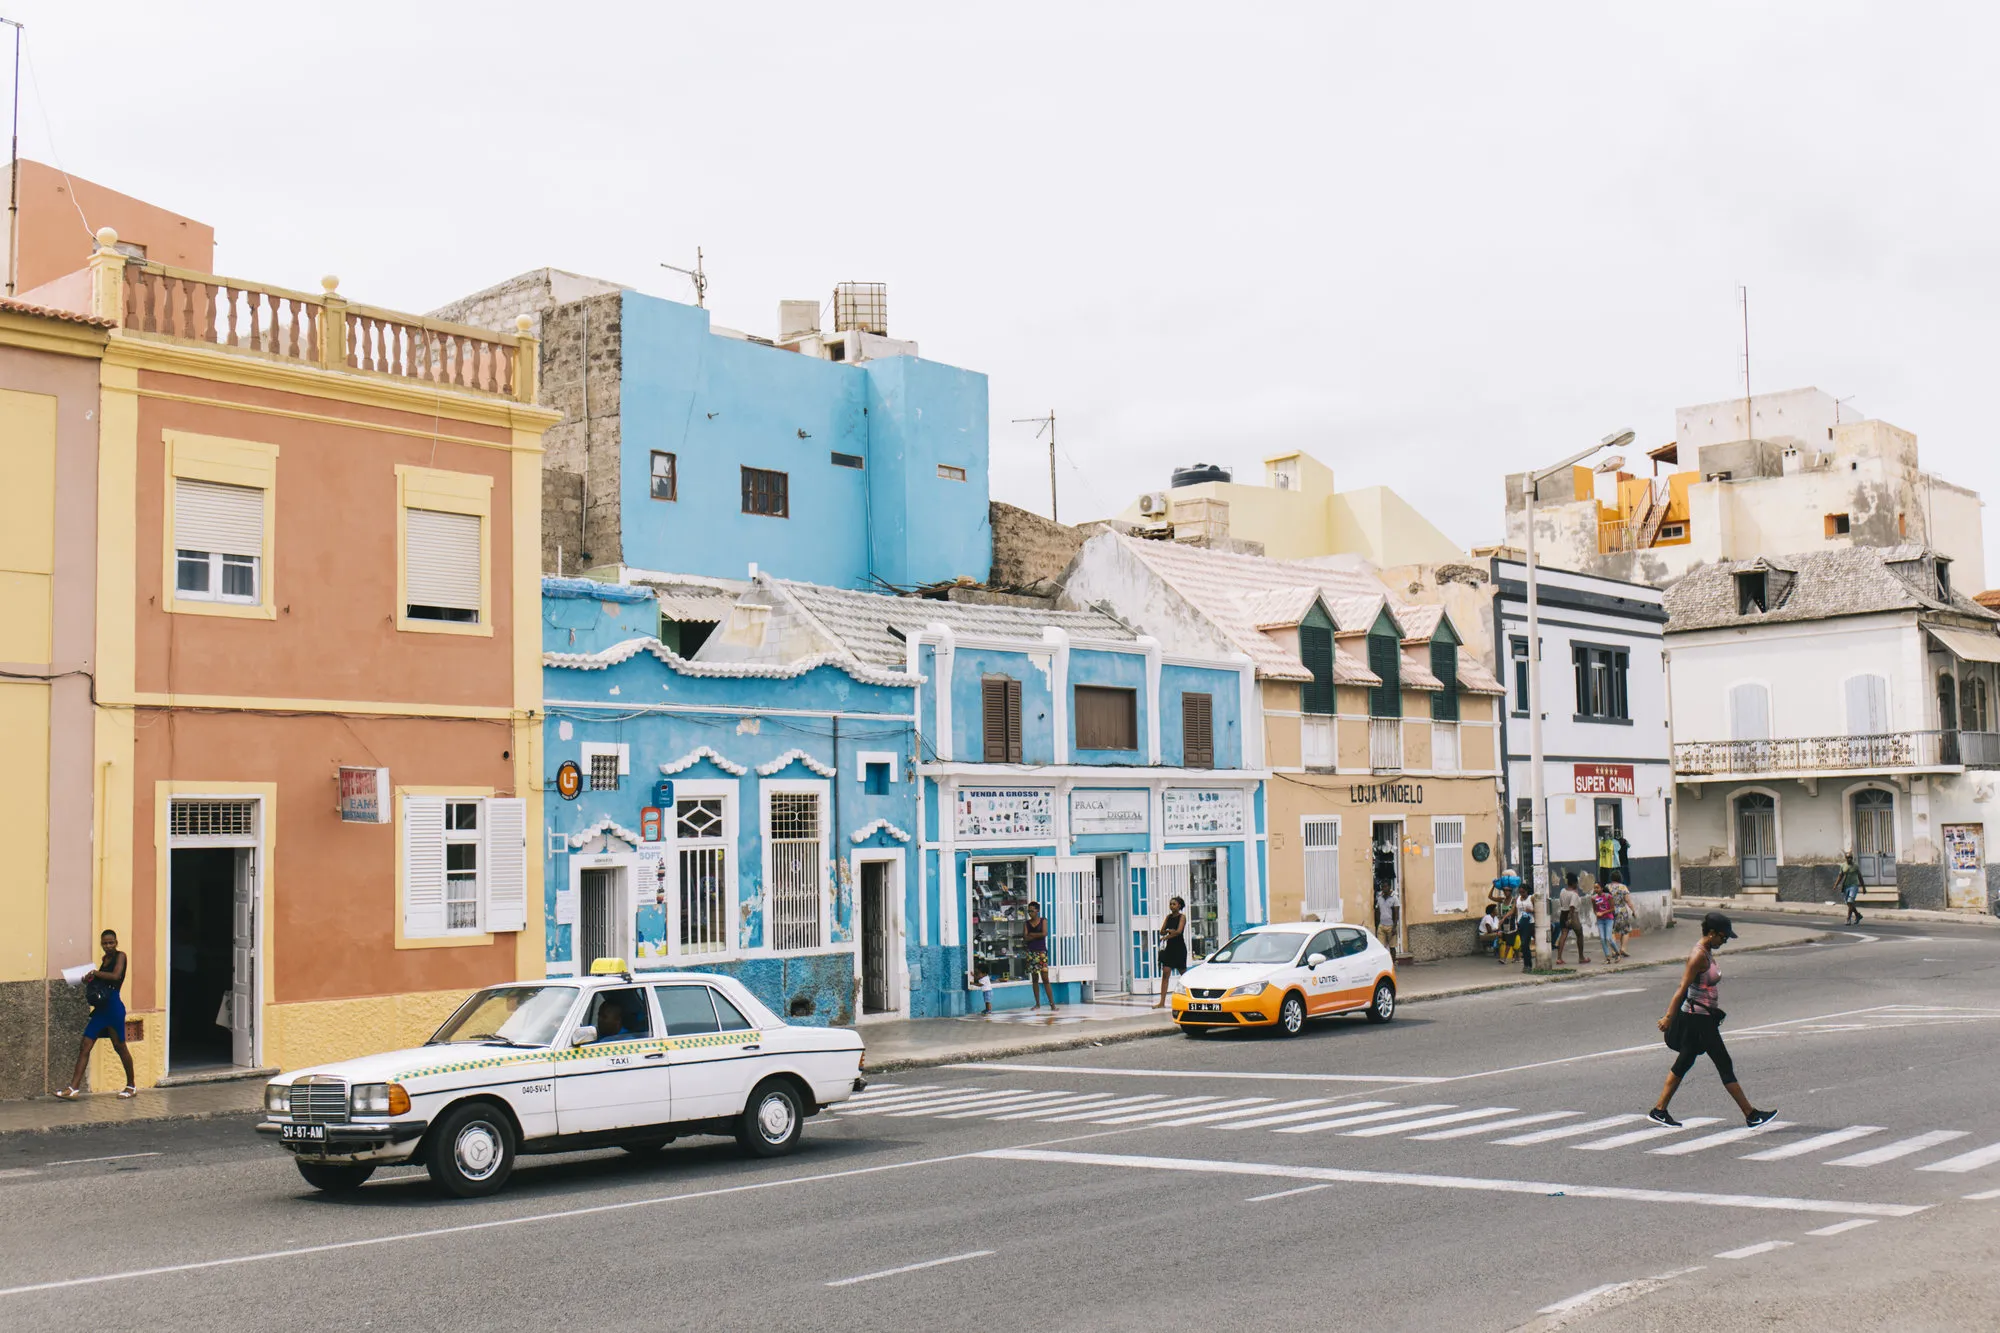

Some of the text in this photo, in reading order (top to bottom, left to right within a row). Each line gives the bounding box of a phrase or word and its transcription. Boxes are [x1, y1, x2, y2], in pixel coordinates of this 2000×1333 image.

[1576, 775, 1633, 793] SUPER CHINA
[1350, 784, 1423, 804] LOJA MINDELO
[1107, 811, 1143, 819] DIGITAL
[522, 1084, 551, 1094] 040-SV-LT
[283, 1125, 323, 1138] SV-87-AM
